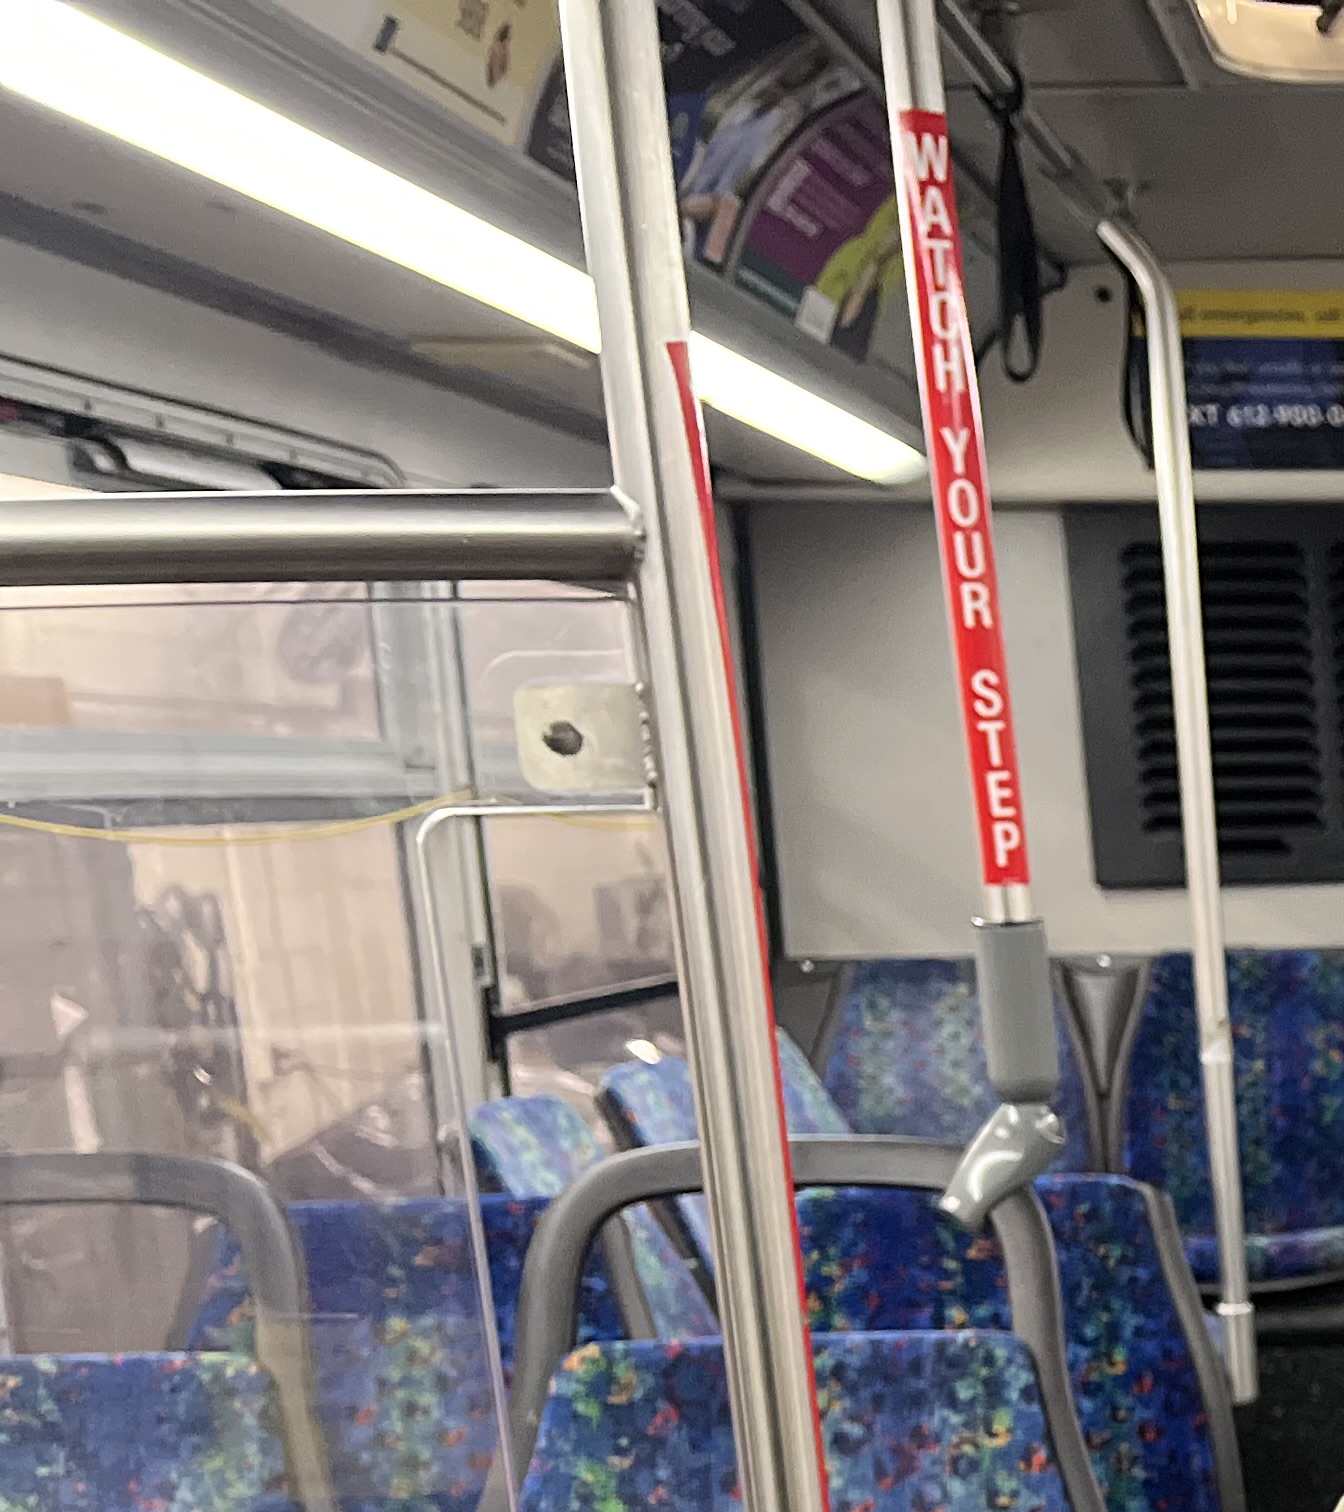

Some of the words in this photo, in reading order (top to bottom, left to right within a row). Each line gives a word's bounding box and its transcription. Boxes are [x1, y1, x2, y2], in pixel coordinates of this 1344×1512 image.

[906, 131, 966, 392] WATCH
[938, 426, 994, 629] YOUR
[970, 667, 1022, 868] STEP
